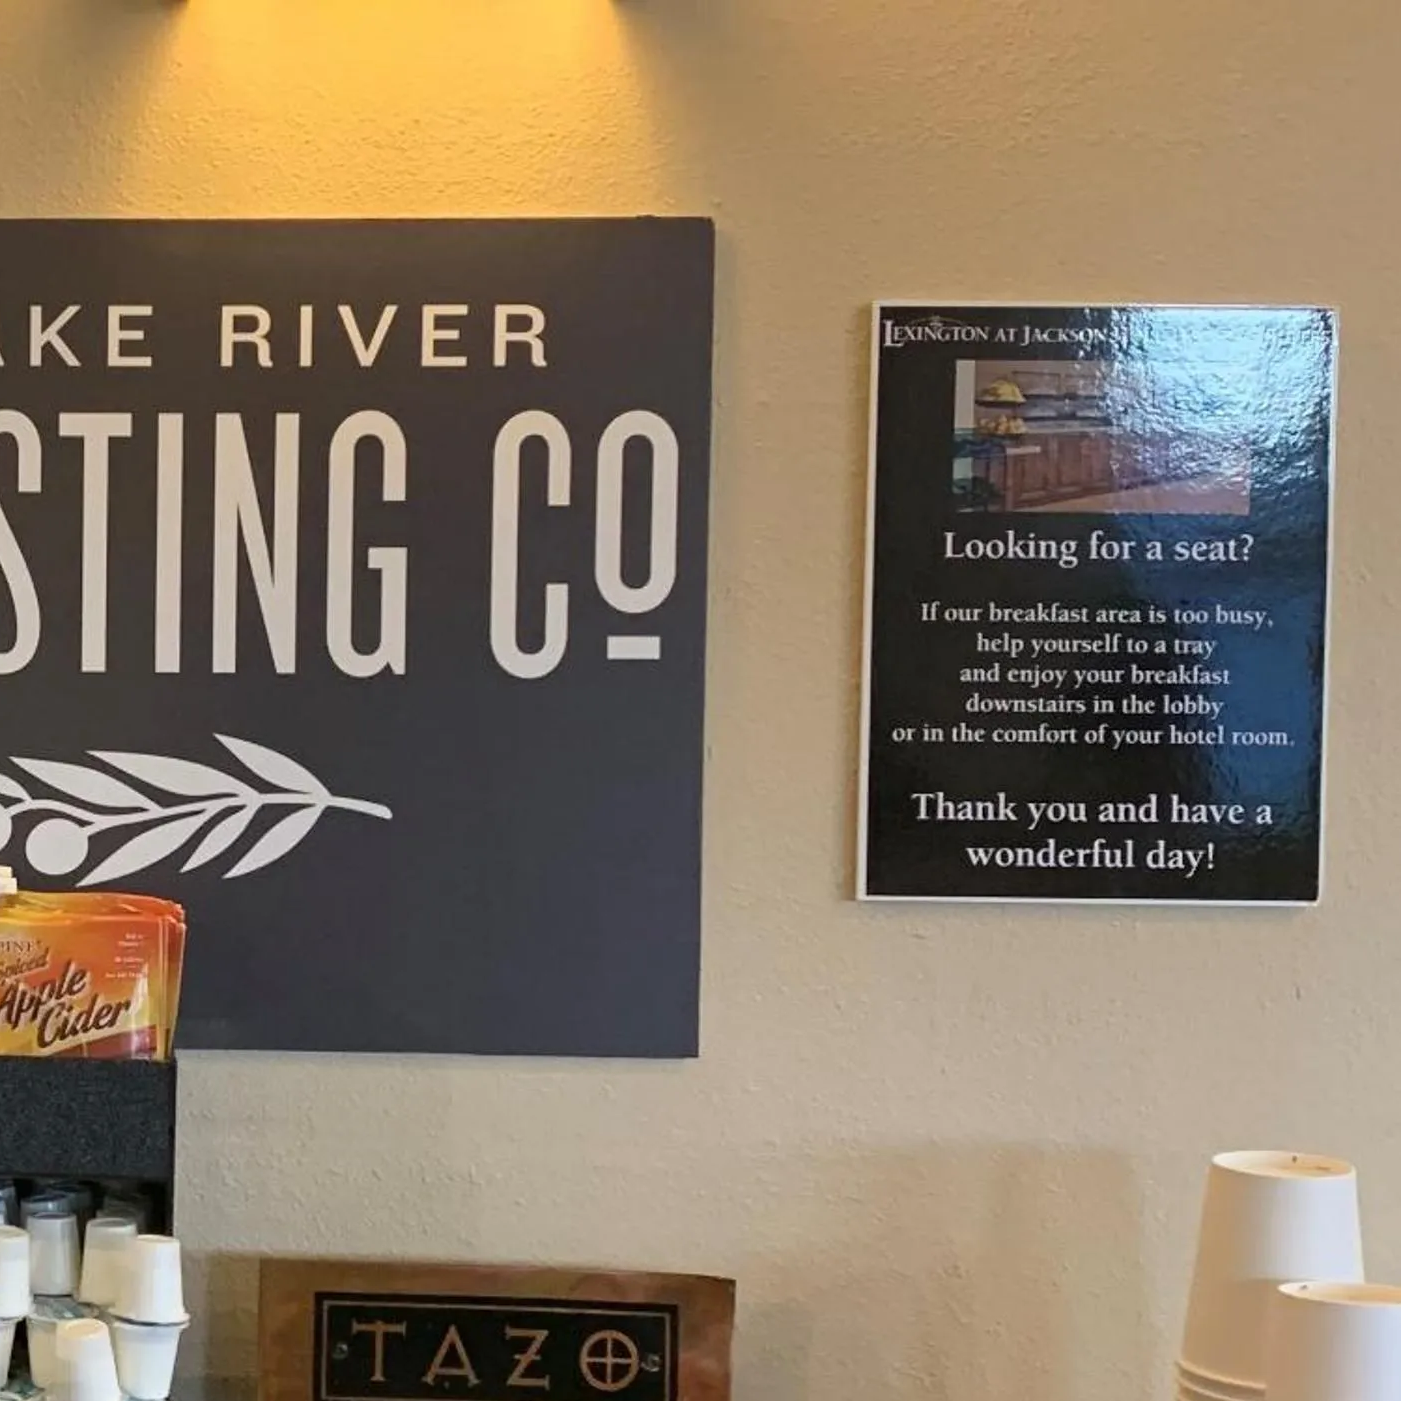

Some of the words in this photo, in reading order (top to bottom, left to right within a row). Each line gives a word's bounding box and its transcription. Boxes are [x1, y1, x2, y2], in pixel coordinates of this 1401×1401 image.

[221, 304, 549, 368] RIVER
[944, 531, 1078, 568] Looking
[1089, 530, 1131, 561] for
[1146, 541, 1163, 561] a
[1174, 534, 1254, 562] seat?
[921, 603, 940, 622] If
[945, 607, 980, 622] our
[989, 603, 1088, 623] breakfast
[1096, 608, 1141, 624] area
[1148, 605, 1166, 624] is
[1174, 608, 1208, 625] too
[1215, 605, 1274, 631] busy,
[977, 633, 1023, 658] help
[1031, 634, 1120, 658] yourself
[1126, 638, 1148, 655] to
[1154, 640, 1167, 655] a
[1173, 639, 1217, 660] tray
[959, 663, 999, 683] and
[1007, 665, 1067, 688] enjoy
[1074, 668, 1122, 688] your
[1131, 664, 1230, 685] breakfast
[966, 693, 1086, 714] downstairs
[1093, 695, 1114, 714] in
[1121, 695, 1155, 714] the
[1162, 696, 1224, 719] lobby
[892, 727, 917, 743] or
[923, 725, 944, 743] in
[951, 723, 984, 743] the
[992, 724, 1077, 744] comfort
[1084, 725, 1108, 745] of
[1112, 729, 1161, 749] your
[1169, 726, 1224, 745] hotel
[1231, 731, 1294, 746] room.
[911, 792, 1018, 822] Thank
[1027, 801, 1086, 829] you
[1099, 797, 1158, 824] and
[1171, 798, 1245, 825] have
[1256, 809, 1273, 826] a
[966, 840, 1134, 870] wonderful
[1146, 842, 1215, 878] day!
[37, 994, 131, 1048] Cider
[351, 1320, 640, 1392] TAZO
